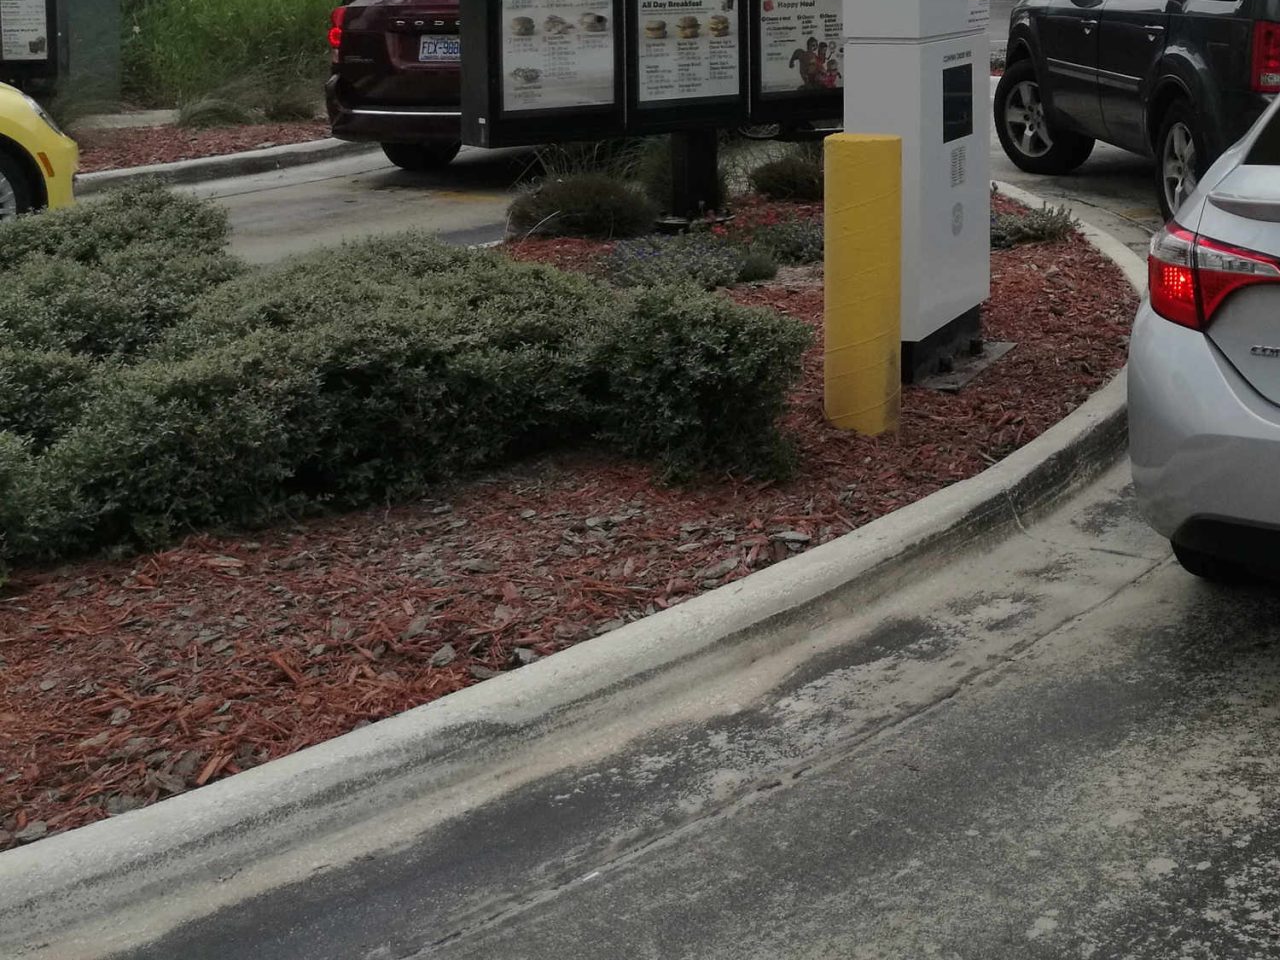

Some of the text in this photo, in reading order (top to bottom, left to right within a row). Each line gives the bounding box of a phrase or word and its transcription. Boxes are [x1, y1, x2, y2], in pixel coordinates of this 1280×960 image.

[653, 1, 667, 9] Day
[668, 0, 703, 8] Breakfast
[777, 1, 798, 9] Happy
